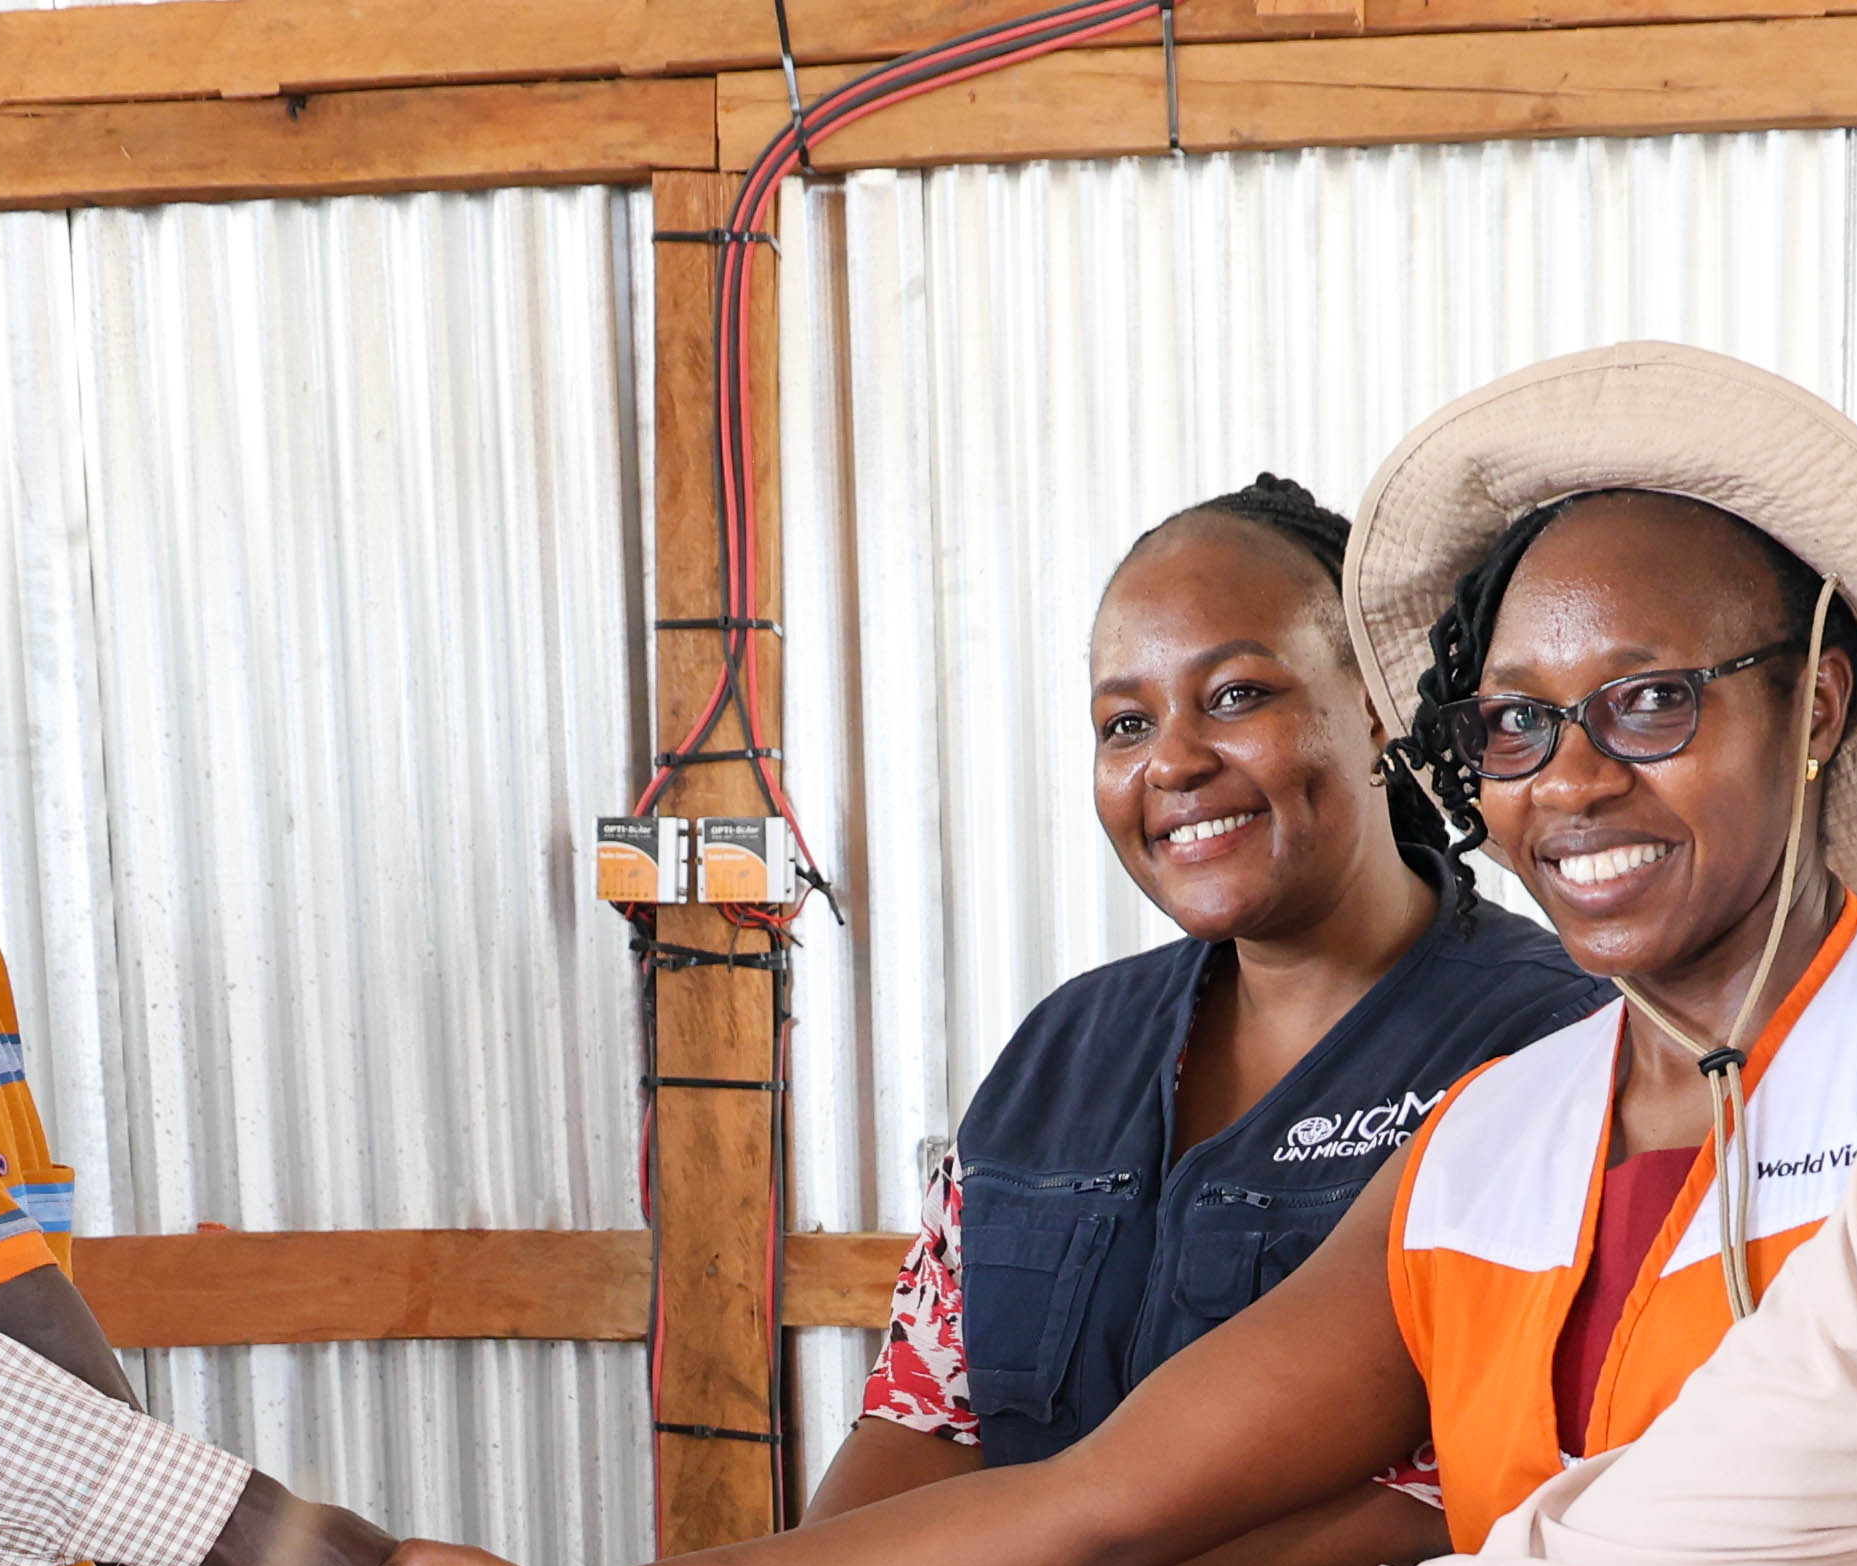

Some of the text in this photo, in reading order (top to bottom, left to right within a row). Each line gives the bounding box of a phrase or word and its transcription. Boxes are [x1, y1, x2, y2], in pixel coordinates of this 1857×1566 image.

[1341, 1089, 1448, 1140] IOM
[1273, 1127, 1413, 1163] UN MIGRATIO
[1757, 1151, 1826, 1180] World
